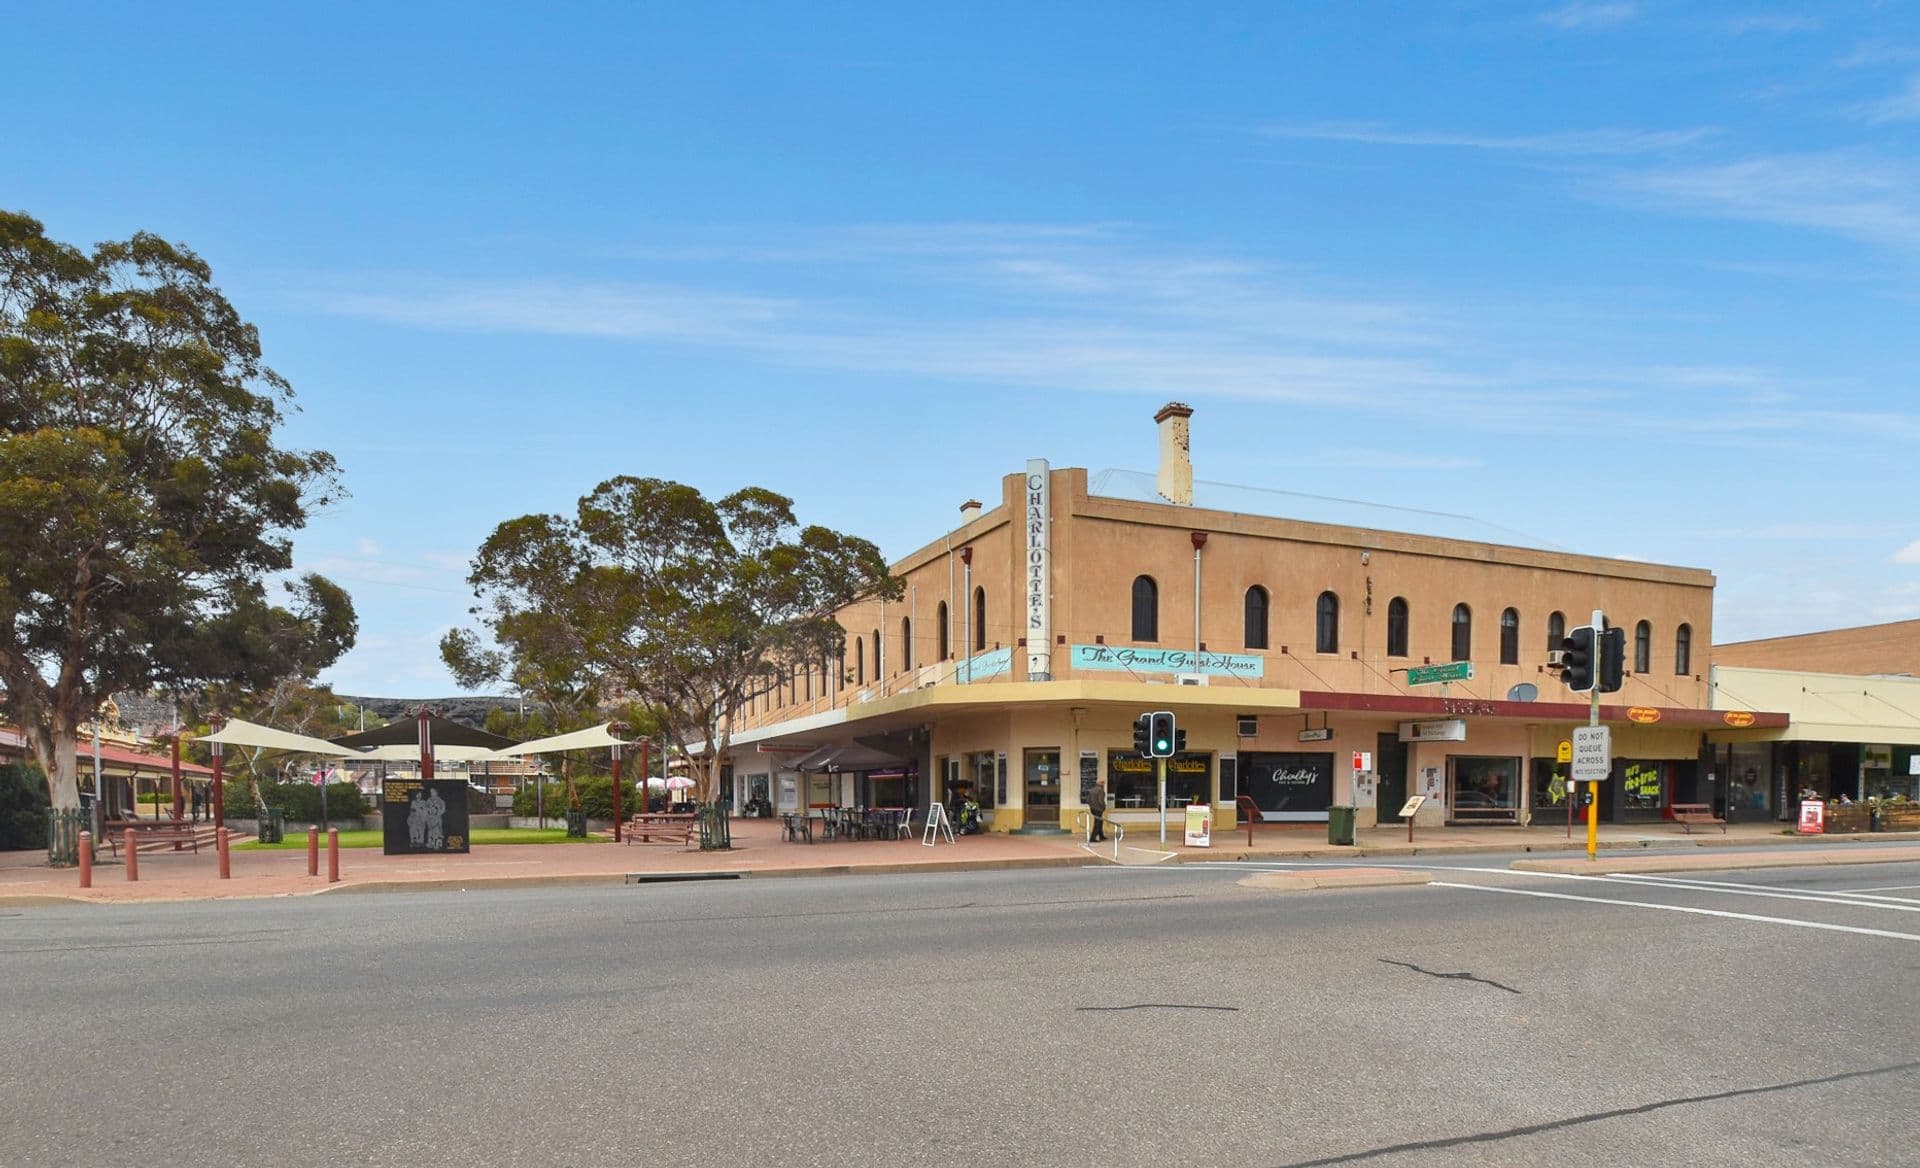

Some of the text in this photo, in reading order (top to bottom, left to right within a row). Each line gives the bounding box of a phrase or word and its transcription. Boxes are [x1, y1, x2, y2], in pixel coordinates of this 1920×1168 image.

[1082, 647, 1113, 662] The
[1117, 650, 1165, 666] Grand
[1211, 655, 1256, 670] House
[1579, 732, 1603, 741] DO NOT
[1579, 744, 1602, 753] QUEUE
